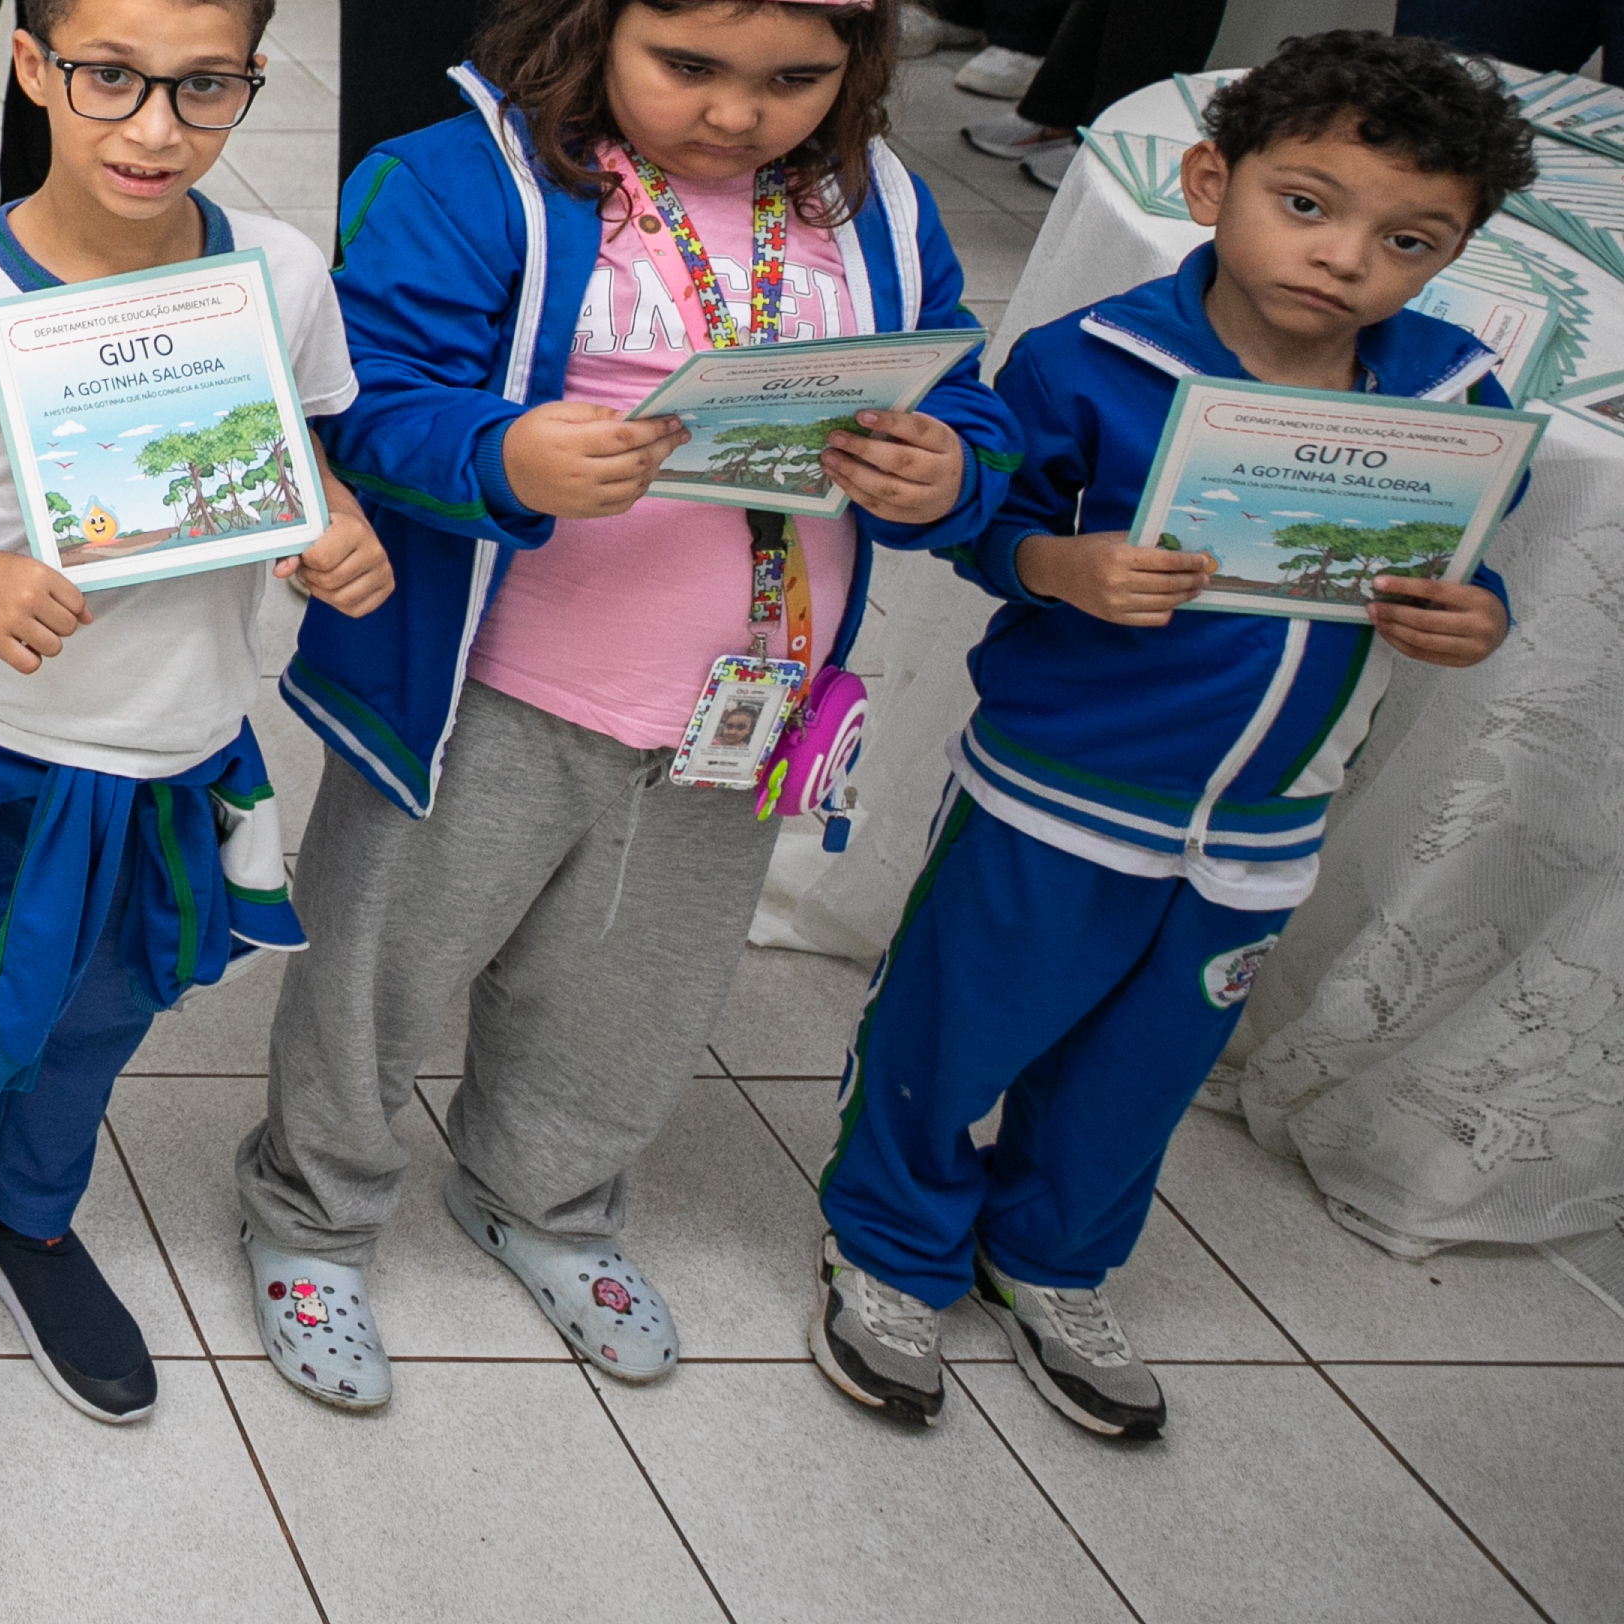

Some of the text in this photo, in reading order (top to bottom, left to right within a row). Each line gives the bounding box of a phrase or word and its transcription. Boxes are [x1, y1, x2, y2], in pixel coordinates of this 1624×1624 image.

[34, 297, 221, 338] DEPARTAMENTO DE EDUCAÇÃO AMBIENTAL
[99, 334, 173, 366] GUTO
[64, 358, 225, 399] A GOTINHA SALOBRA
[761, 375, 840, 390] GUTO
[718, 394, 788, 404] GOTINHA
[793, 389, 864, 400] SALOBRA
[1235, 415, 1323, 430] DEPARTAMENTO
[1343, 426, 1404, 438] EDUCAÇÃO
[1406, 433, 1466, 445] AMBIENTAL
[1296, 445, 1386, 468] GUTO
[1234, 463, 1429, 492] A GOTINHA SALOBRA
